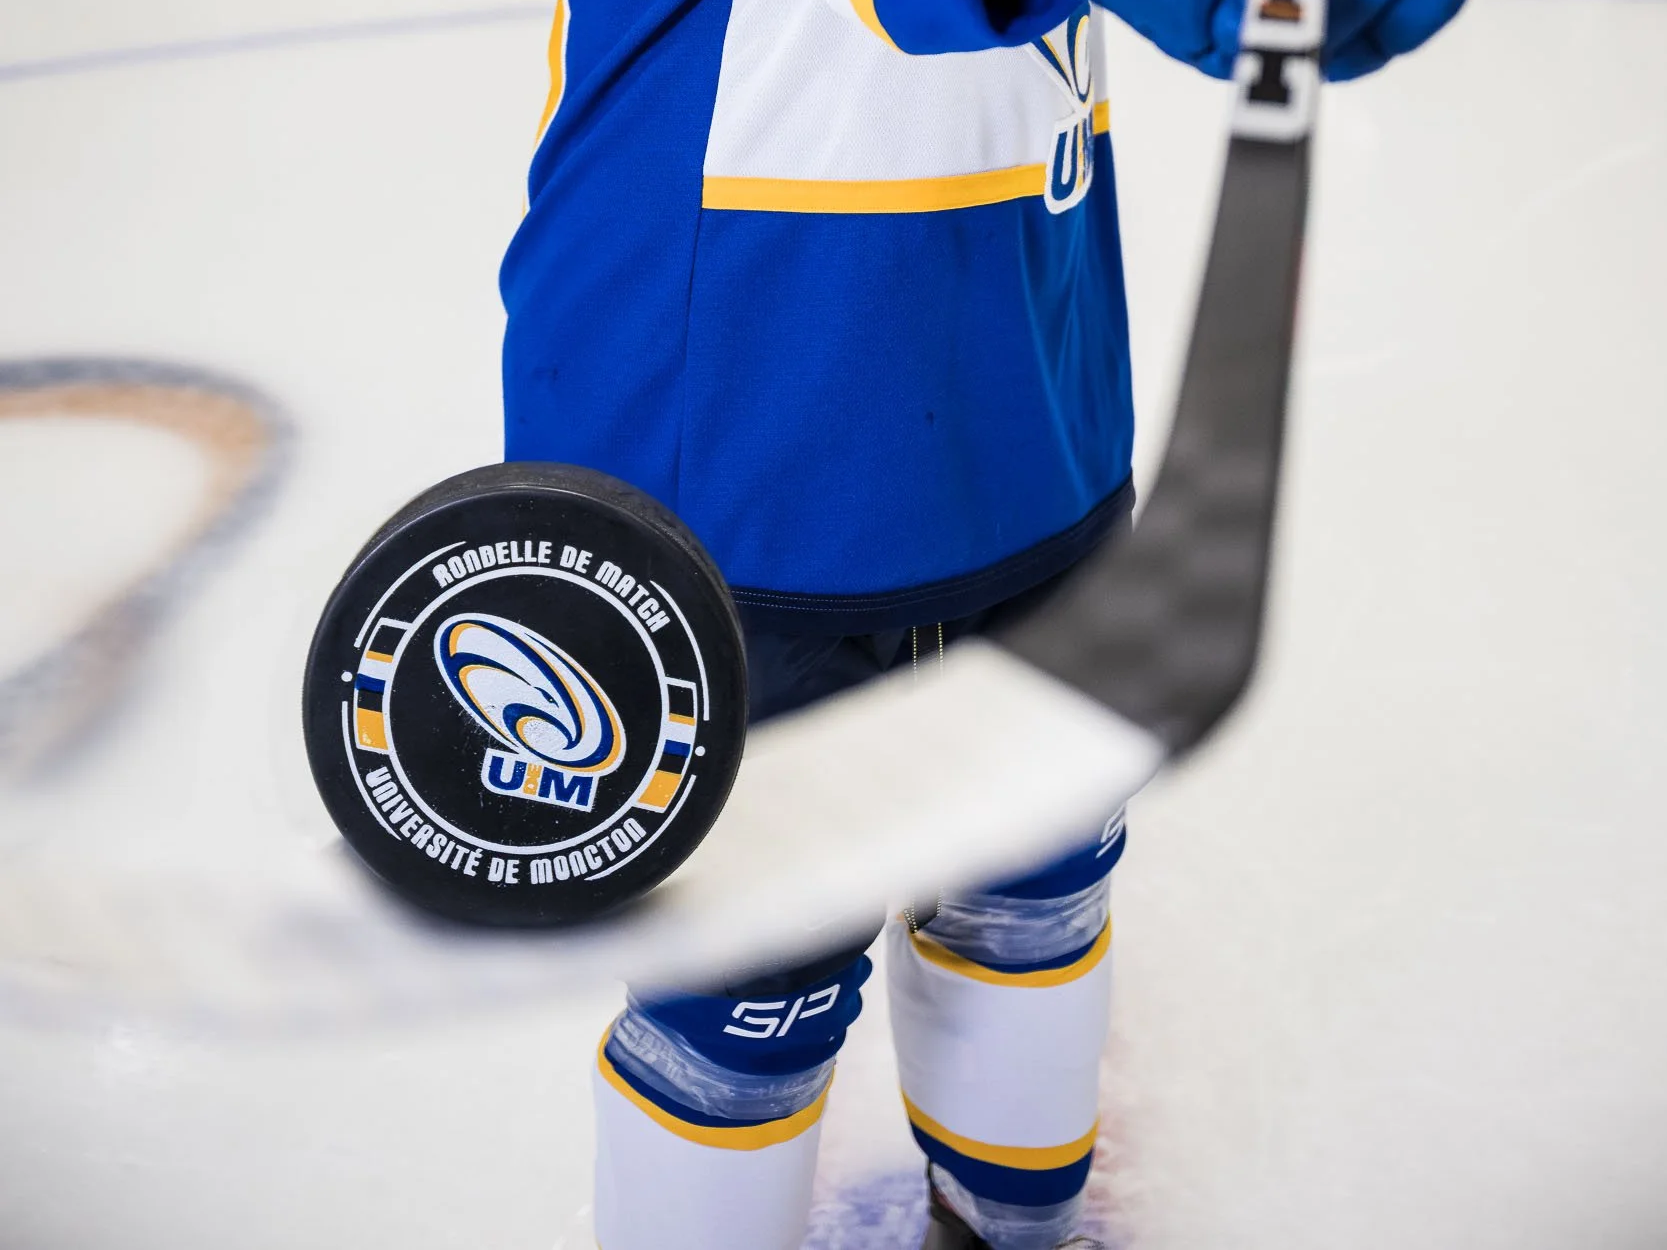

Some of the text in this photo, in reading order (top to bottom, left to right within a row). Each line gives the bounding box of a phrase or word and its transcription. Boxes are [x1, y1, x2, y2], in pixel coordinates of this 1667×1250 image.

[431, 540, 672, 634] RONDELLE DE MATCH
[364, 765, 647, 886] UNIVERSITÉ DE MONCTON
[723, 982, 841, 1039] SP
